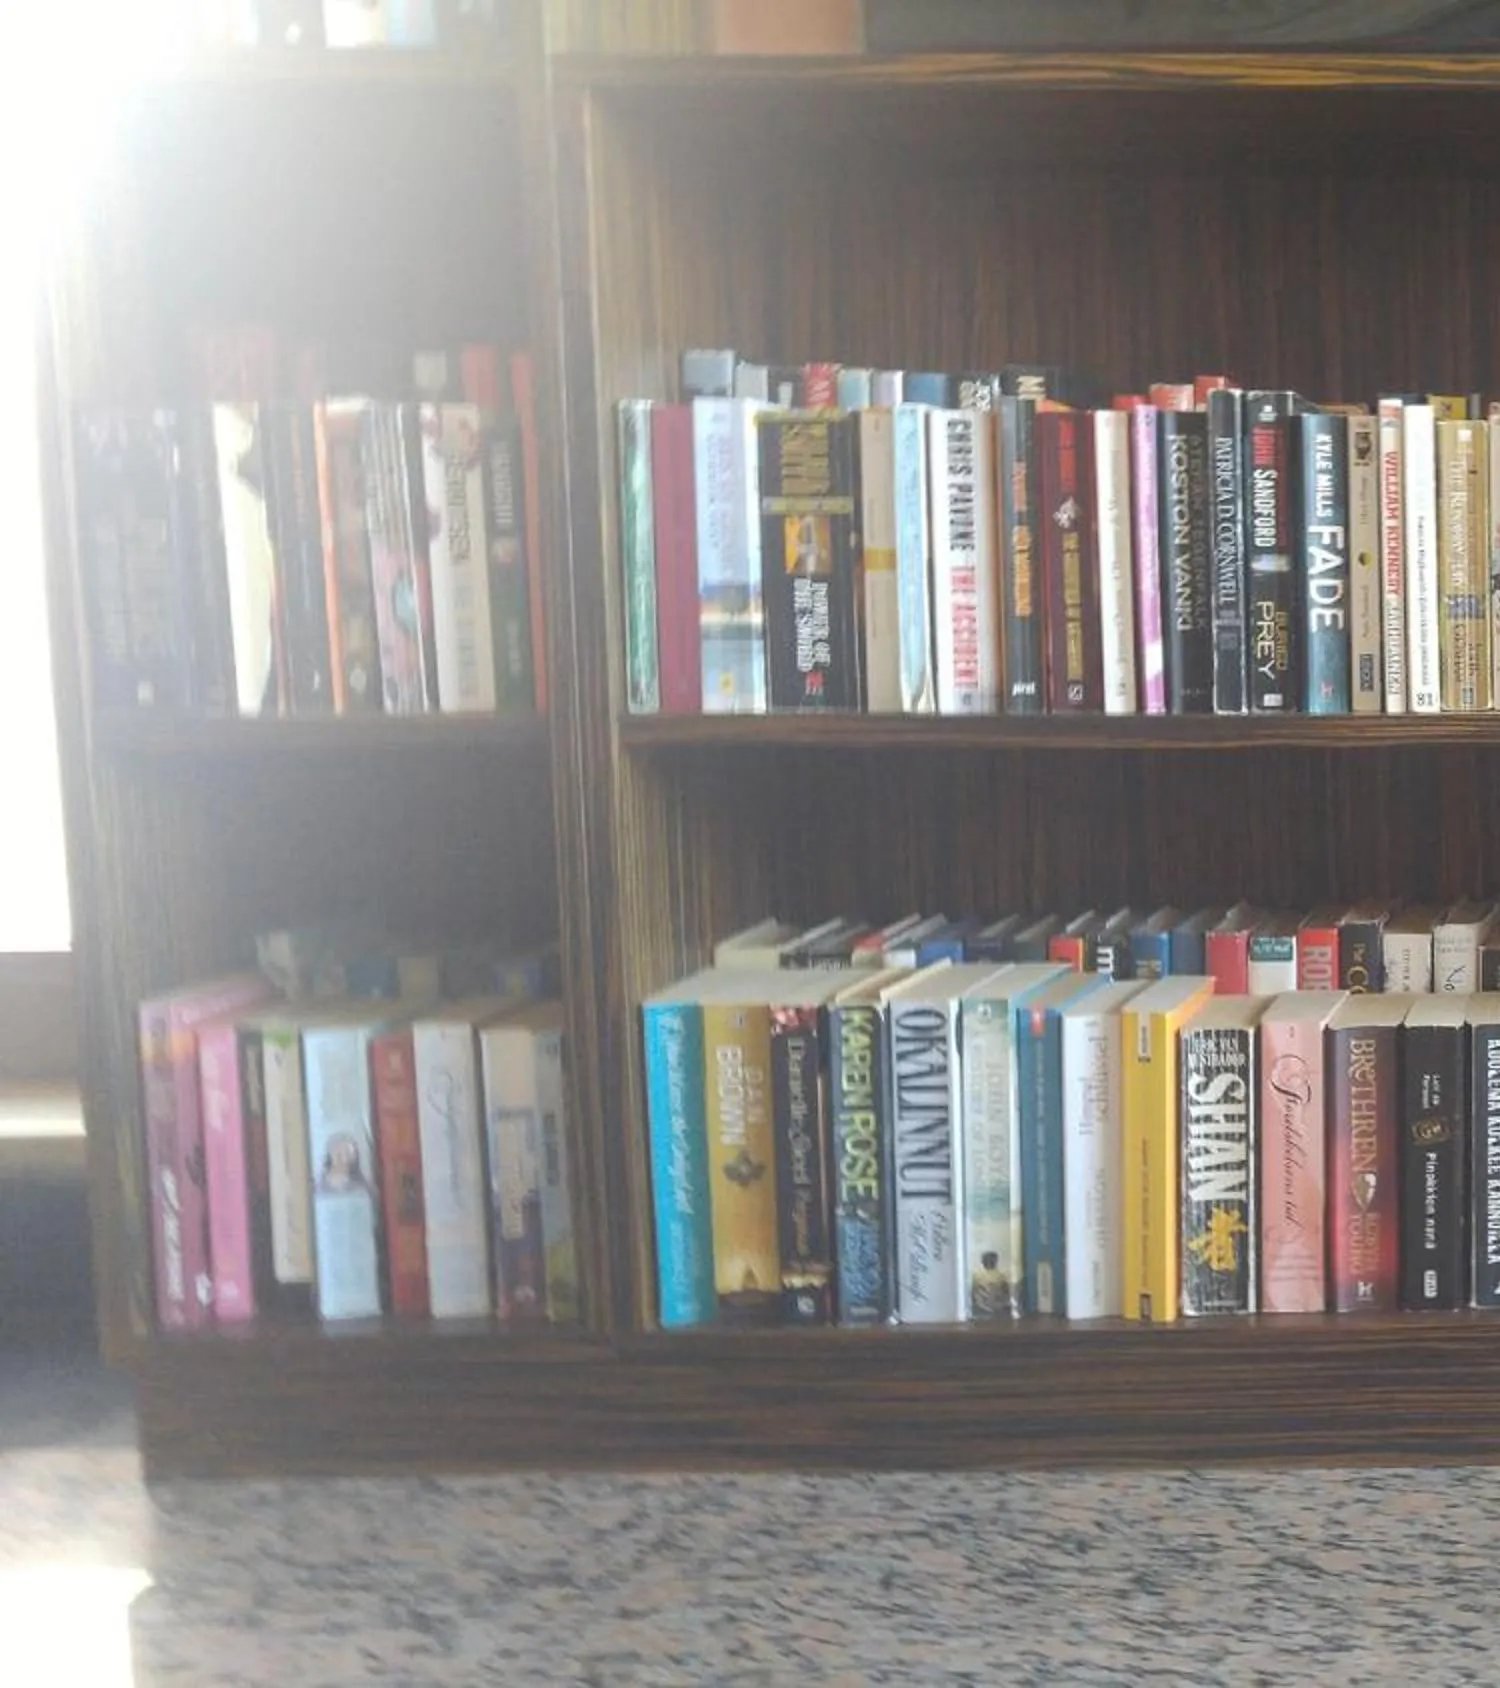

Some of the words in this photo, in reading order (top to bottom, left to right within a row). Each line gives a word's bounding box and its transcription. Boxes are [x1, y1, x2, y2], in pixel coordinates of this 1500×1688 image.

[948, 419, 974, 476] CHRIS
[1214, 436, 1234, 501] PATRICIA
[1252, 426, 1276, 466] JOHN
[1313, 433, 1332, 470] KYLE
[1385, 450, 1402, 521] WILLIAM
[949, 483, 976, 552] PAVONE
[1168, 434, 1191, 544] KOSTON
[1252, 468, 1277, 548] SANDFORD
[1315, 473, 1334, 518] MILLS
[951, 564, 977, 594] THE
[1174, 552, 1193, 631] VANKI
[1214, 522, 1236, 605] CORNWELL
[1308, 524, 1344, 634] FADE
[952, 602, 979, 690] ACCIDENT
[1255, 601, 1275, 680] PREY
[716, 1046, 745, 1146] BROWN
[840, 1010, 877, 1107] KAREN
[895, 1008, 952, 1206] OKALINNUT
[1188, 1072, 1247, 1203] SHAN
[838, 1111, 879, 1203] ROSE
